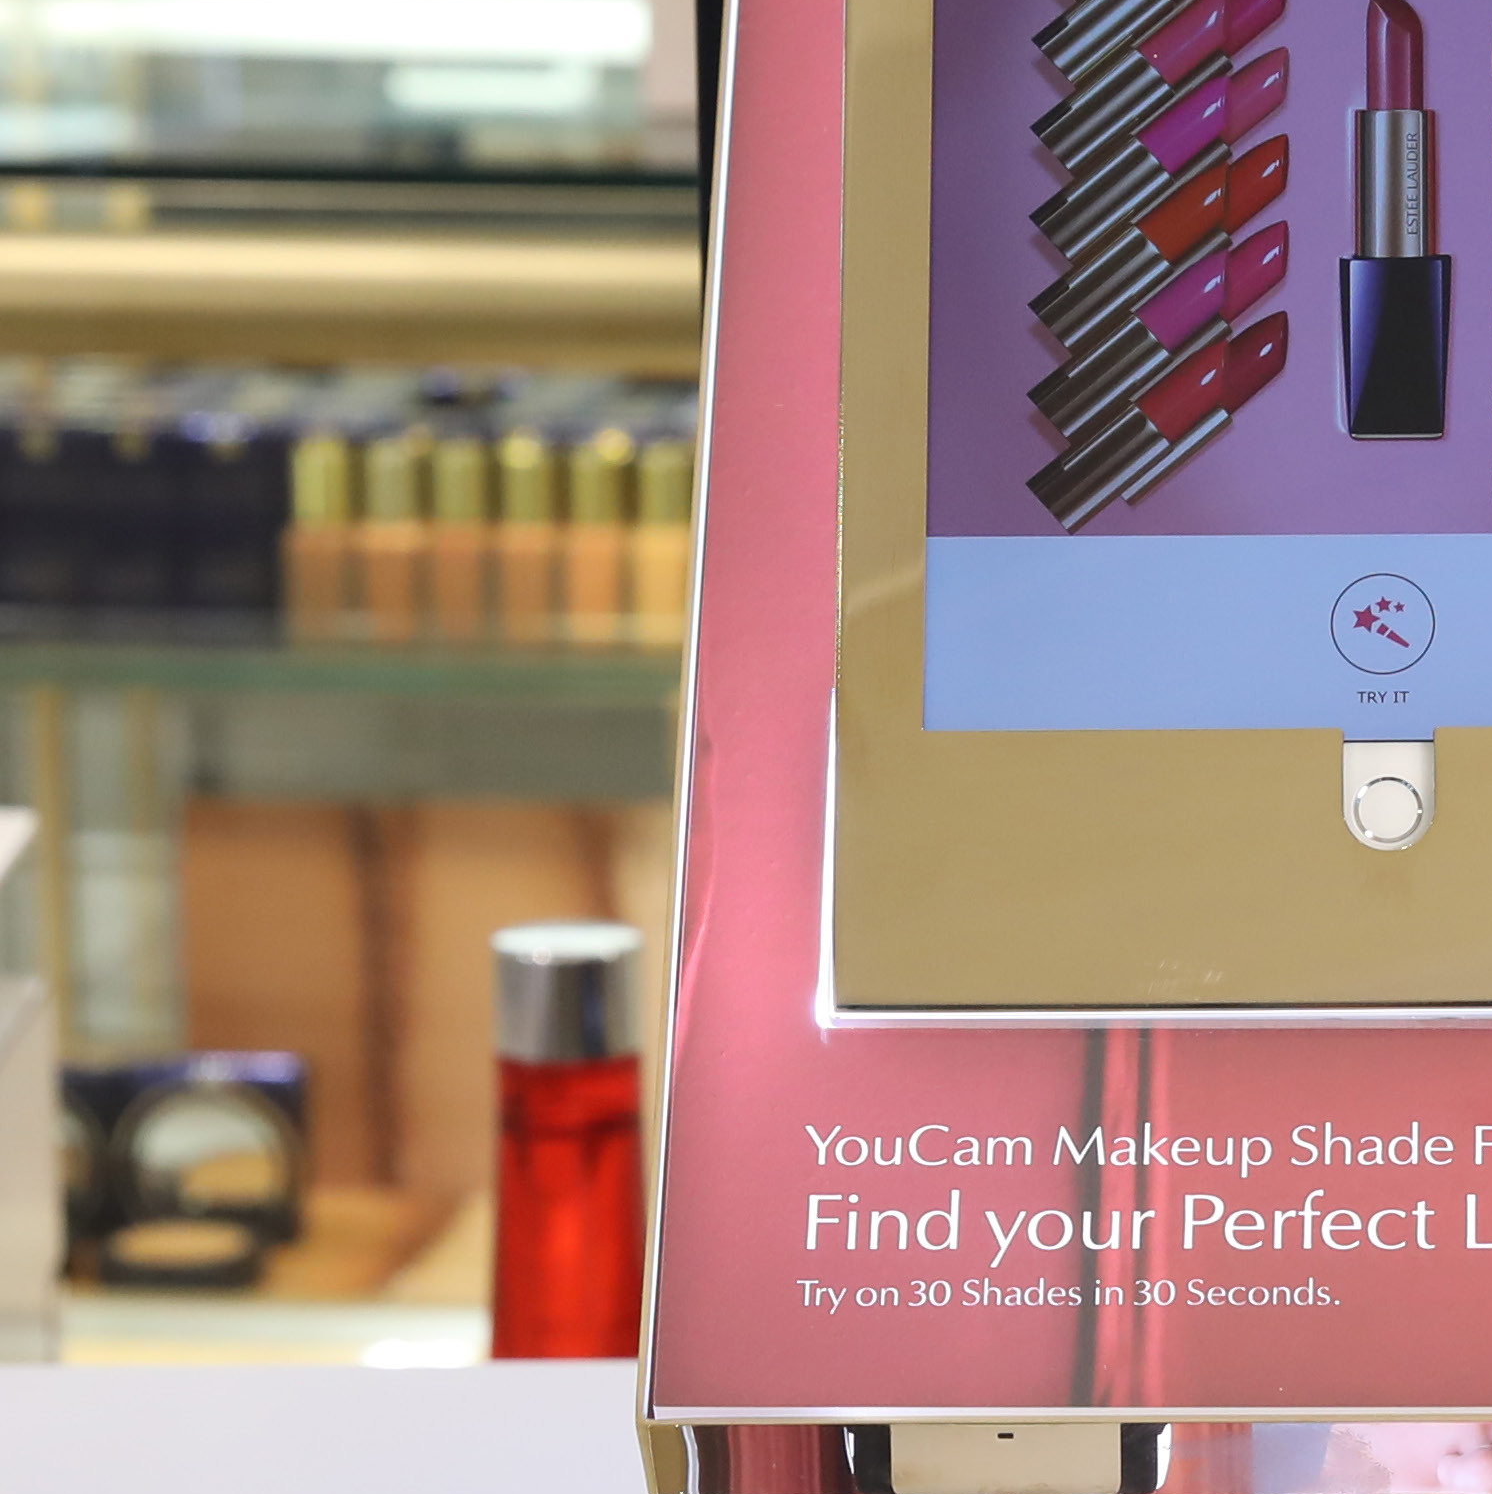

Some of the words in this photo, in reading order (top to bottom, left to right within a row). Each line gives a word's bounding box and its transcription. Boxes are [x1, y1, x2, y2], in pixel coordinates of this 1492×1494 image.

[1405, 131, 1419, 190] LAUDER
[1357, 691, 1388, 704] TRY
[1393, 691, 1410, 704] IT
[804, 1124, 1033, 1167] YouCam
[1052, 1122, 1273, 1179] Makeup
[1289, 1121, 1455, 1167] Shade
[805, 1189, 961, 1251] Find
[983, 1209, 1156, 1269] your
[1182, 1189, 1437, 1251] Perfect
[796, 1279, 847, 1315] Try
[855, 1286, 900, 1307] on
[907, 1279, 952, 1307] 30
[962, 1277, 1083, 1307] Shades
[1094, 1279, 1124, 1306] in
[1133, 1279, 1176, 1307] 30
[1186, 1277, 1341, 1307] Seconds.
